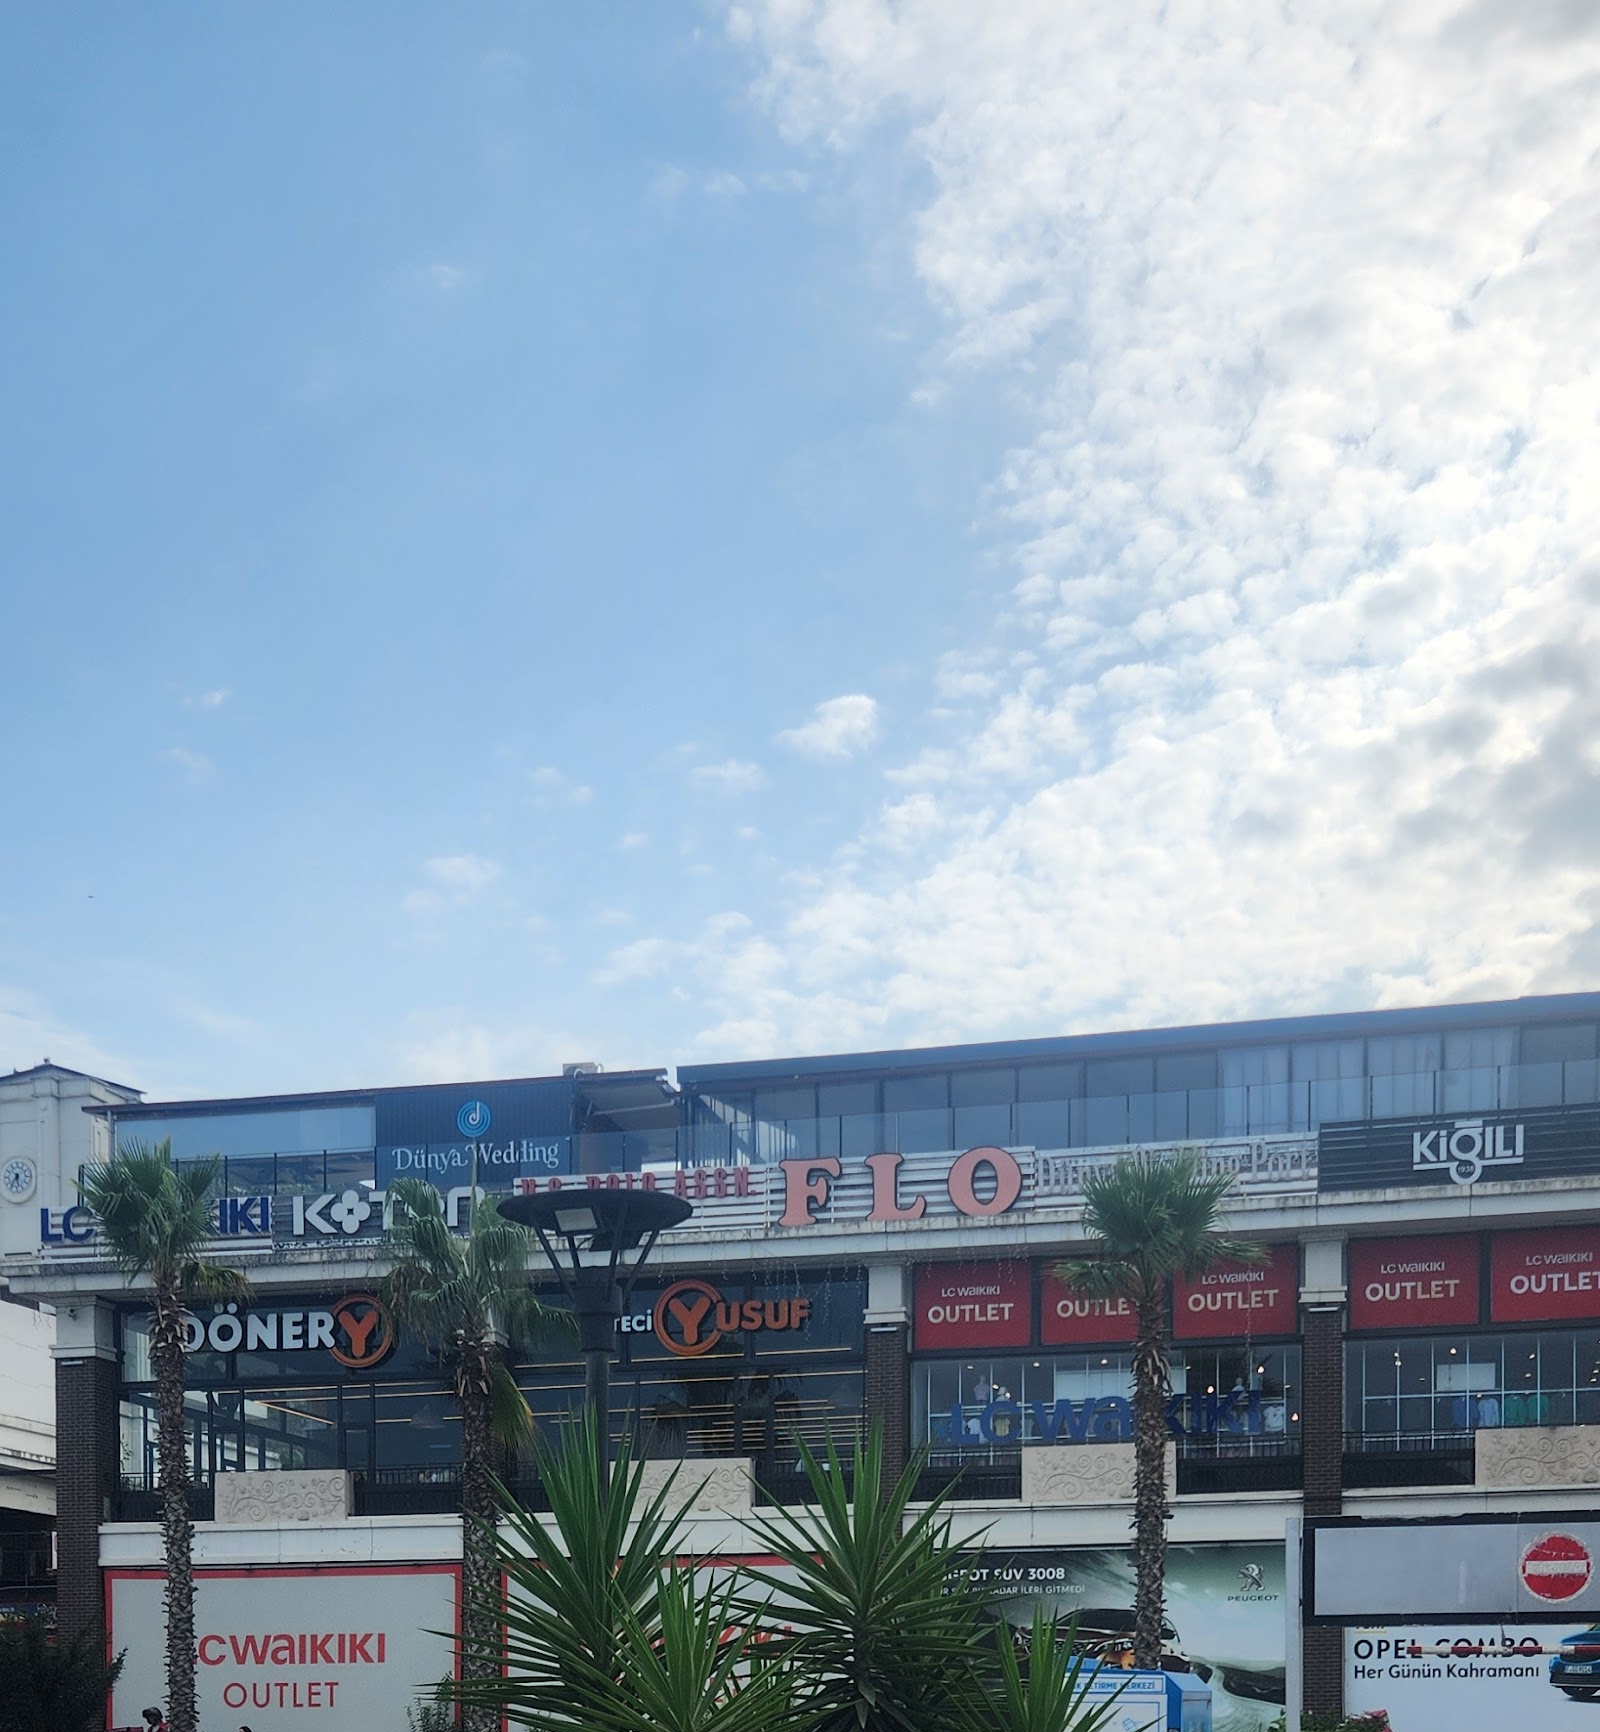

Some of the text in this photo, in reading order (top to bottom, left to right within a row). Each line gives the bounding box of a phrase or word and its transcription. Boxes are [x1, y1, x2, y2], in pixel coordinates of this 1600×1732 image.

[392, 1139, 559, 1174] Dünya Wedding
[674, 1167, 756, 1199] ASSN.
[778, 1146, 1022, 1227] FLO
[40, 1206, 96, 1242] LC
[1380, 1264, 1396, 1274] LC
[1526, 1255, 1542, 1266] LC
[1202, 1275, 1217, 1285] LC
[1365, 1280, 1460, 1301] OUTLET
[941, 1288, 956, 1298] LC
[1188, 1289, 1279, 1312] OUTLET
[927, 1303, 1014, 1324] OUTLET
[1056, 1297, 1130, 1318] OUTLE
[184, 1303, 335, 1352] DÖNER
[668, 1296, 810, 1345] YUSUF
[994, 1567, 1023, 1581] SUV
[1028, 1567, 1066, 1580] 3008
[990, 1587, 1018, 1595] ADAR
[1045, 1583, 1085, 1594] GİTMEDİ
[1227, 1594, 1279, 1602] PEUGEOT
[1354, 1638, 1424, 1660] OPEL
[1354, 1662, 1539, 1679] Her Günün Kahramanı
[223, 1682, 339, 1709] OUTLET
[1121, 1681, 1155, 1690] ERKEZİ
